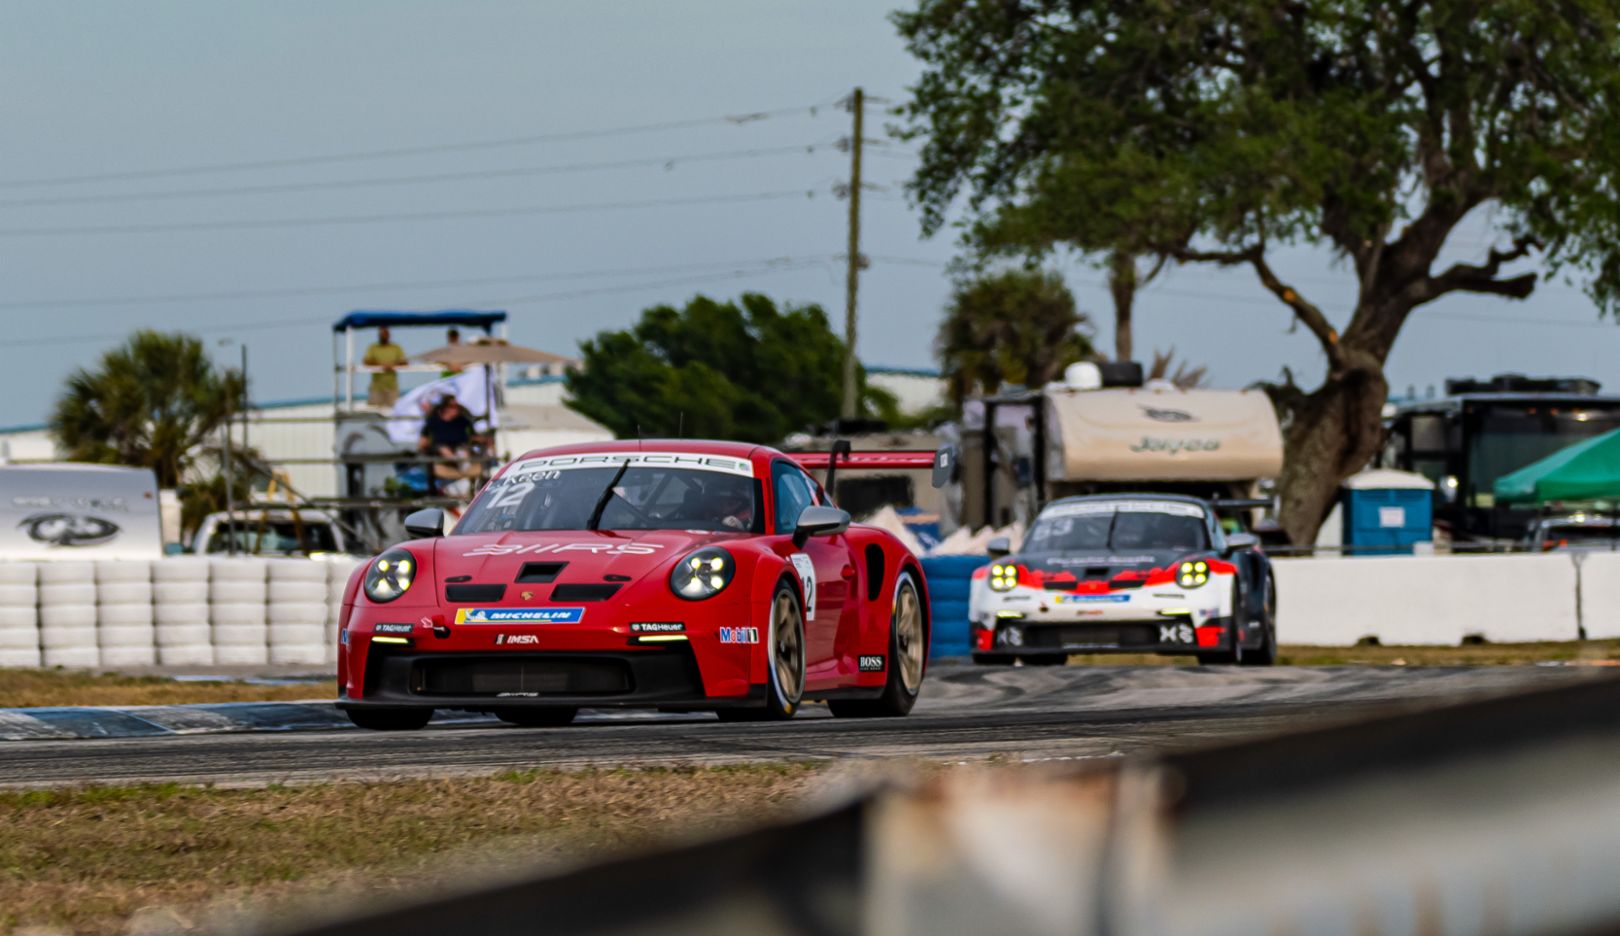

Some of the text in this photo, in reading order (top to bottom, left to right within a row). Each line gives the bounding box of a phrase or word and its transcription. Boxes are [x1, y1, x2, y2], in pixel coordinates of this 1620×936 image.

[1129, 436, 1220, 456] Jayco
[519, 455, 736, 471] PORSCHE
[486, 481, 536, 509] 12
[490, 611, 572, 619] MICHELIN
[507, 634, 540, 644] IMSA
[720, 627, 748, 643] Mobil
[860, 656, 882, 667] BOSS
